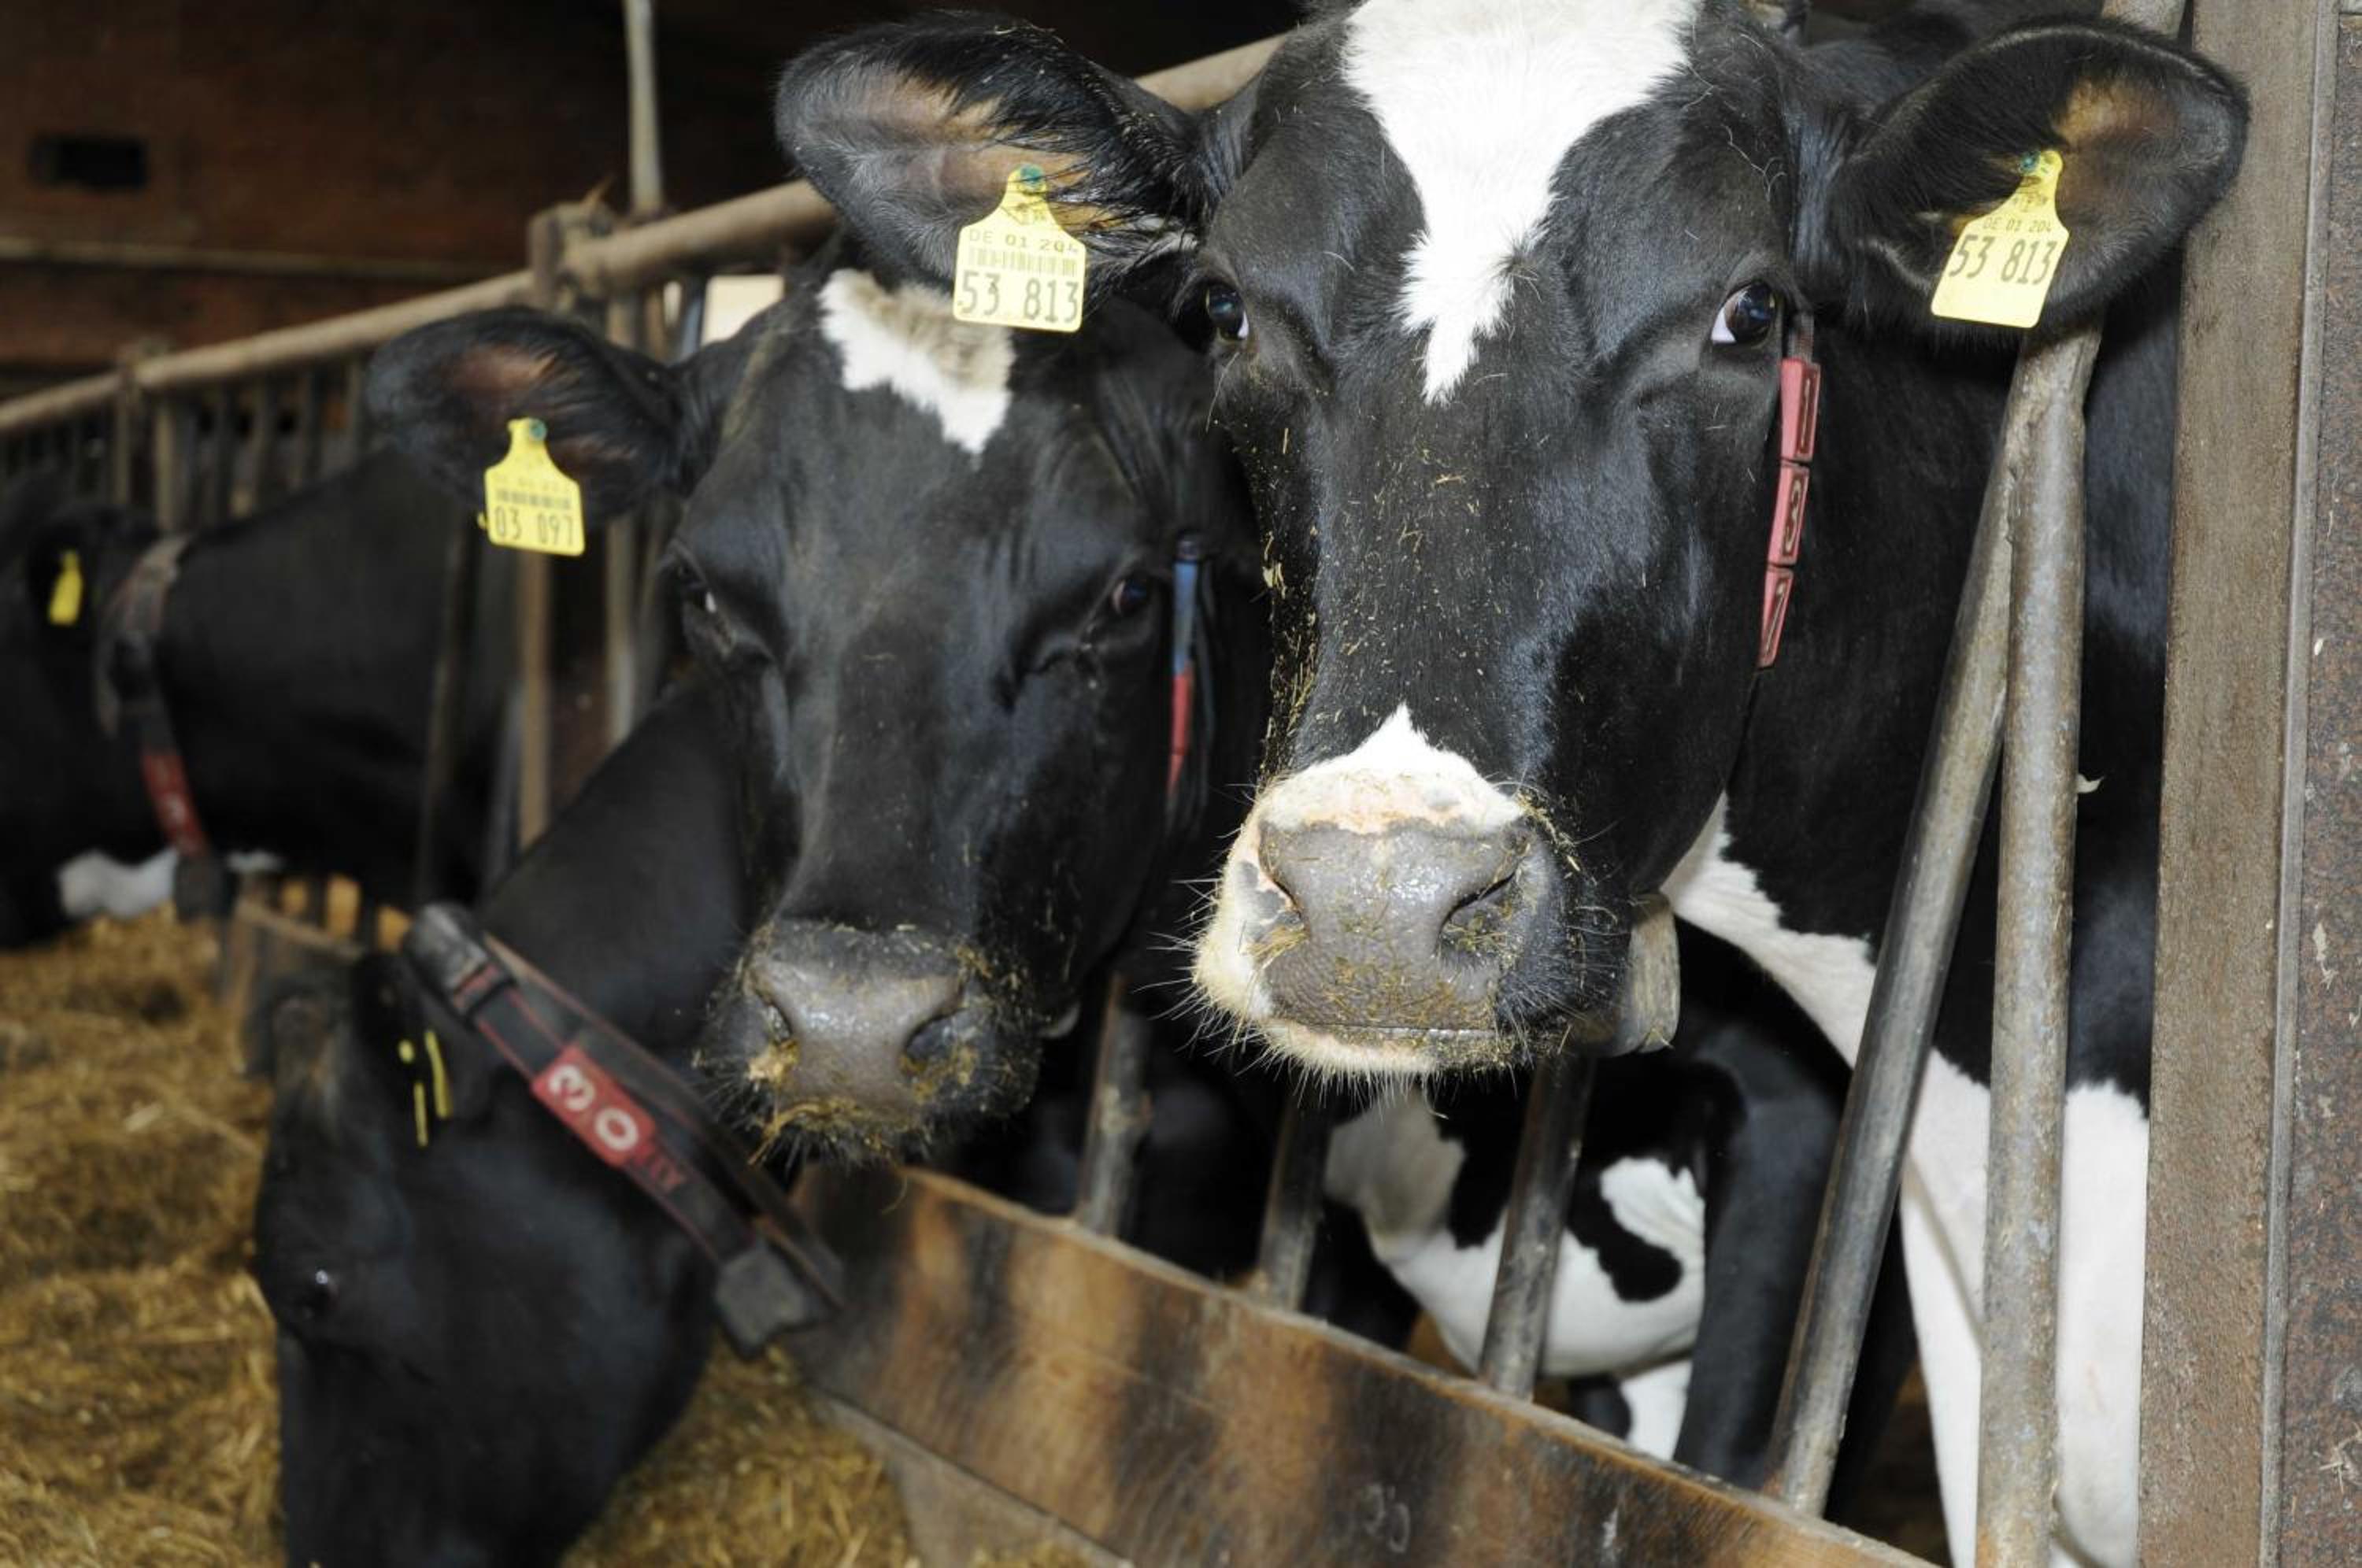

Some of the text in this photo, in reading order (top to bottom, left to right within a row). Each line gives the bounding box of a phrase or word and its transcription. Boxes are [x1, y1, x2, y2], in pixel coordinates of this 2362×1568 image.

[968, 230, 994, 245] DE
[1004, 234, 1028, 250] 01
[1948, 234, 2059, 286] 53 813
[961, 271, 1079, 324] 53 813
[494, 505, 573, 546] 03 097
[548, 1064, 639, 1152] 30
